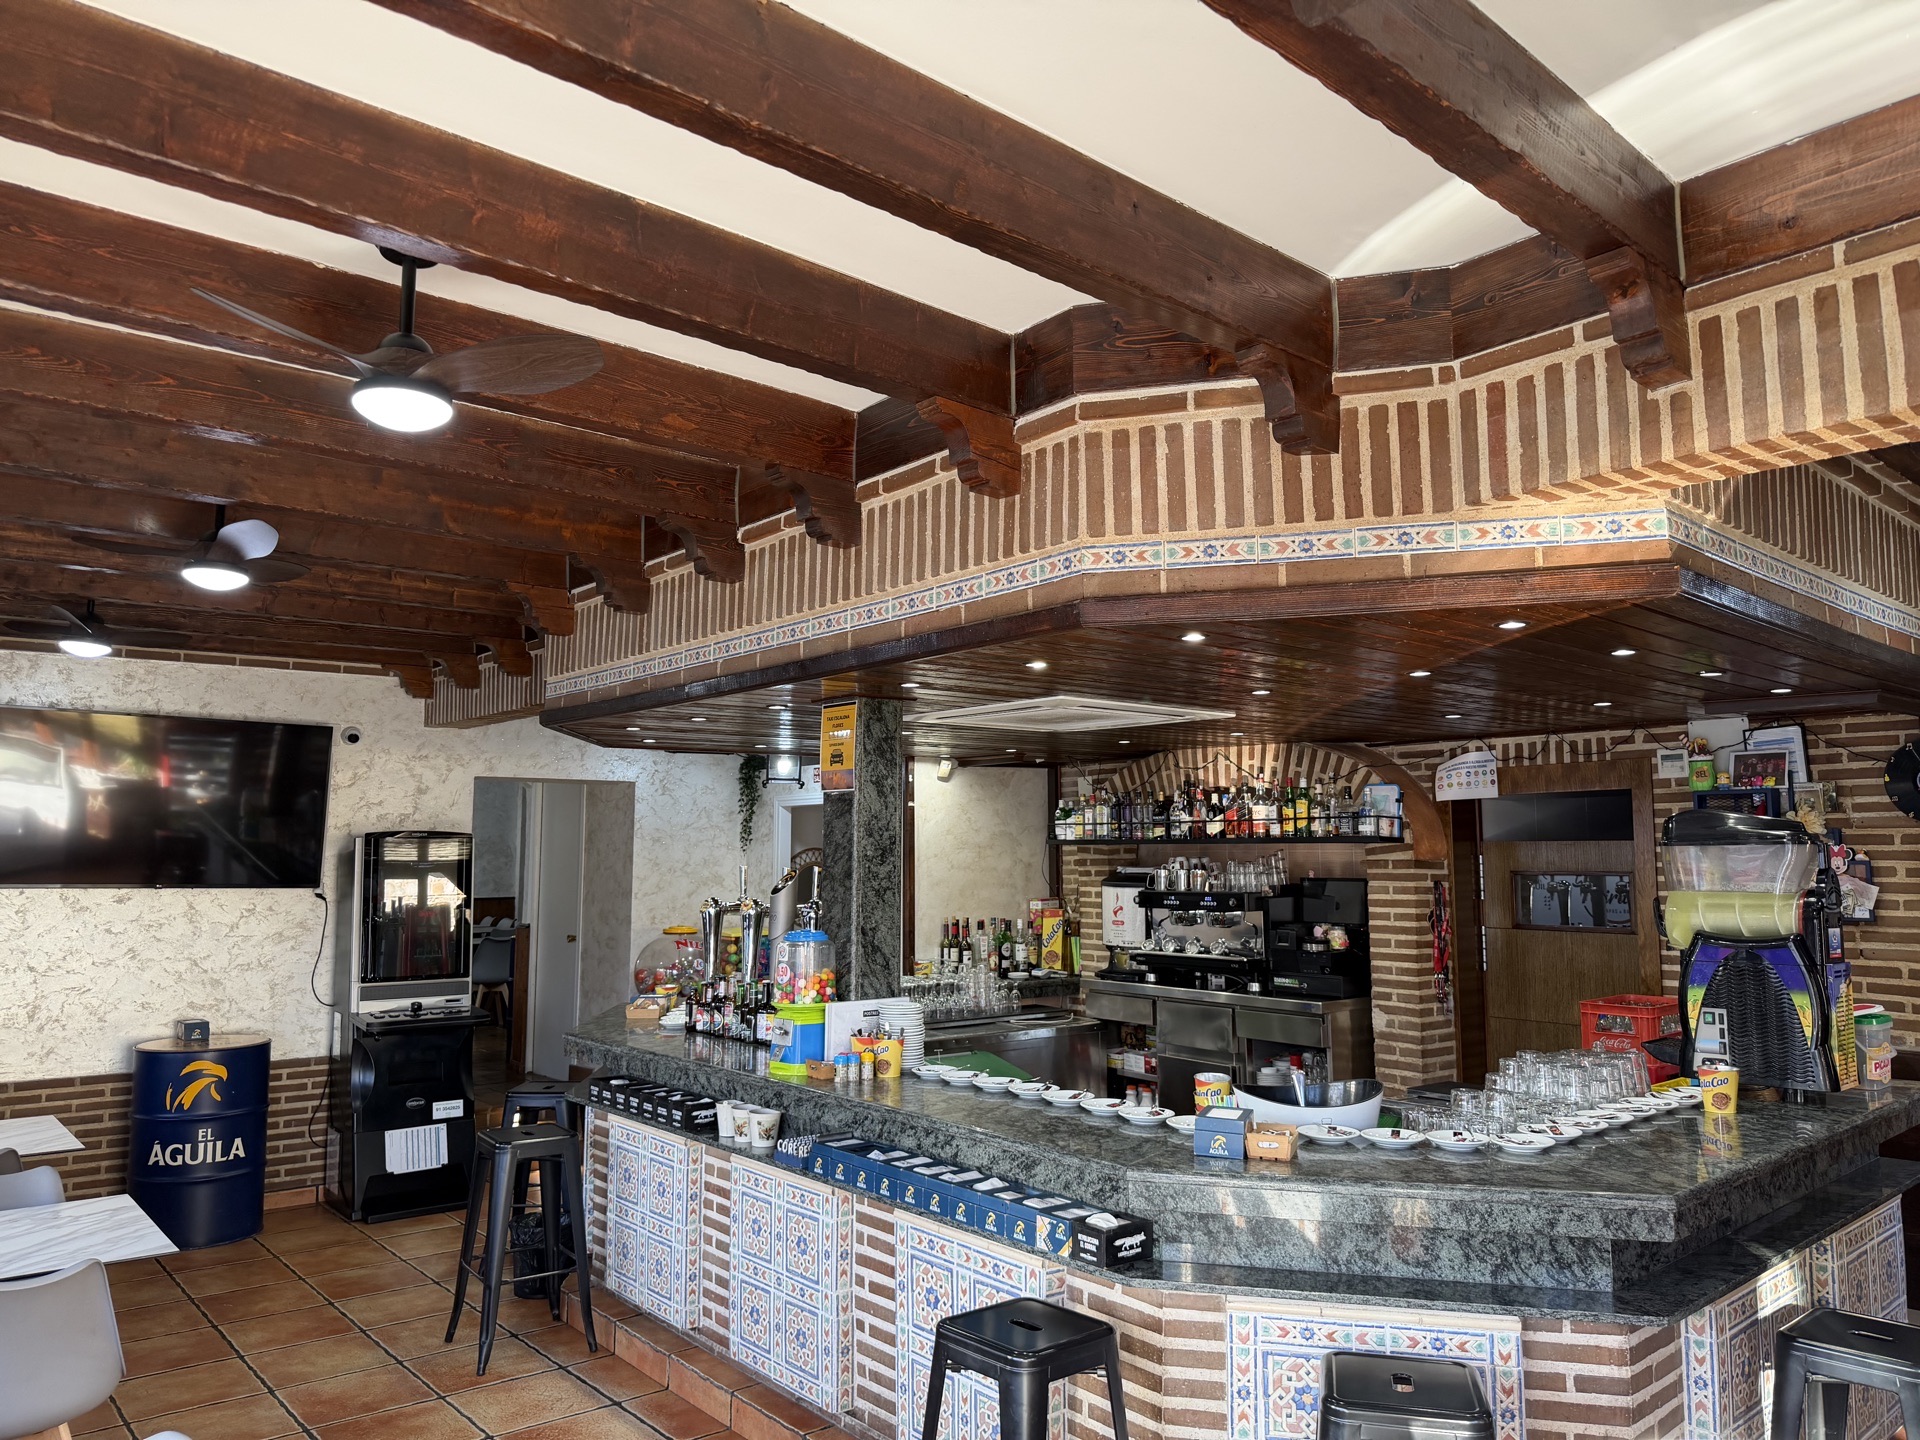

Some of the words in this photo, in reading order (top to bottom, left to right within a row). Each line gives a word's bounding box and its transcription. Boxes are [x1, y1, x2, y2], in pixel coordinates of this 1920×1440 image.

[1695, 770, 1708, 778] SEL
[198, 1128, 215, 1141] EL
[148, 1137, 246, 1166] ÁGUILA
